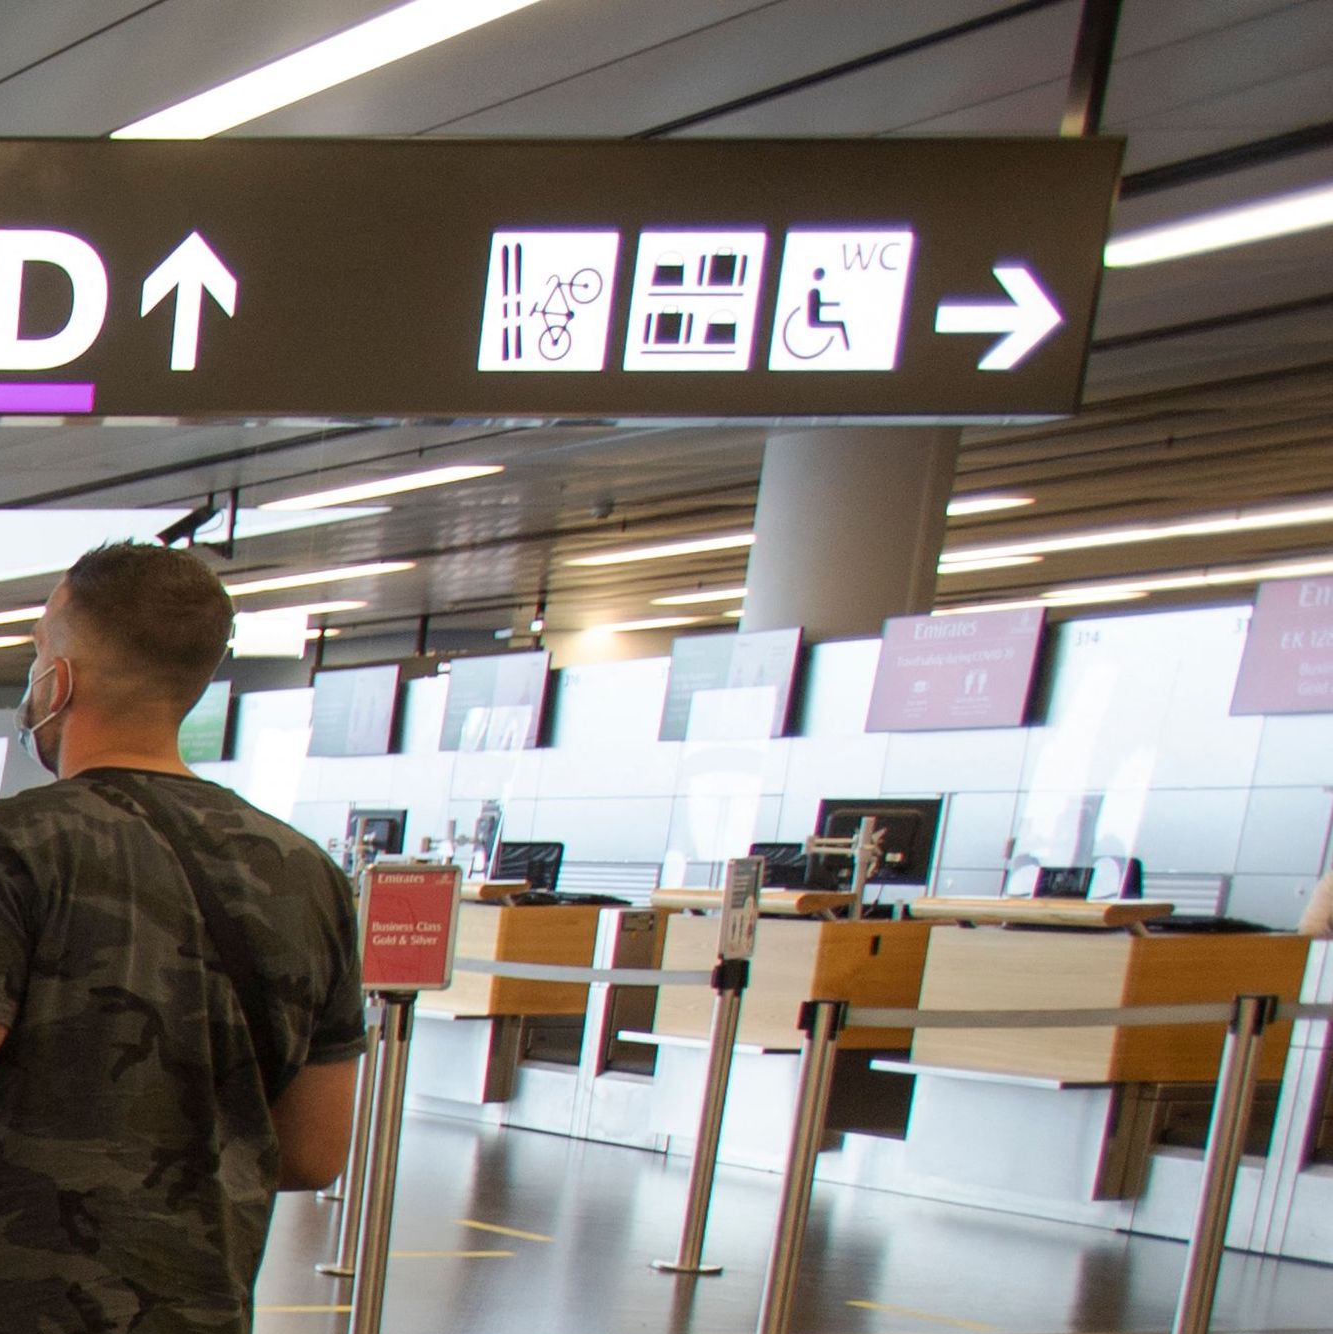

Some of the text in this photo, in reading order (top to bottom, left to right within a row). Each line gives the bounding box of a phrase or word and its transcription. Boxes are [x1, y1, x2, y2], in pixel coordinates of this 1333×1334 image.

[842, 242, 901, 271] WC
[377, 873, 425, 885] Emirates
[371, 921, 442, 933] Business Class
[372, 935, 438, 946] Gold & Silver
